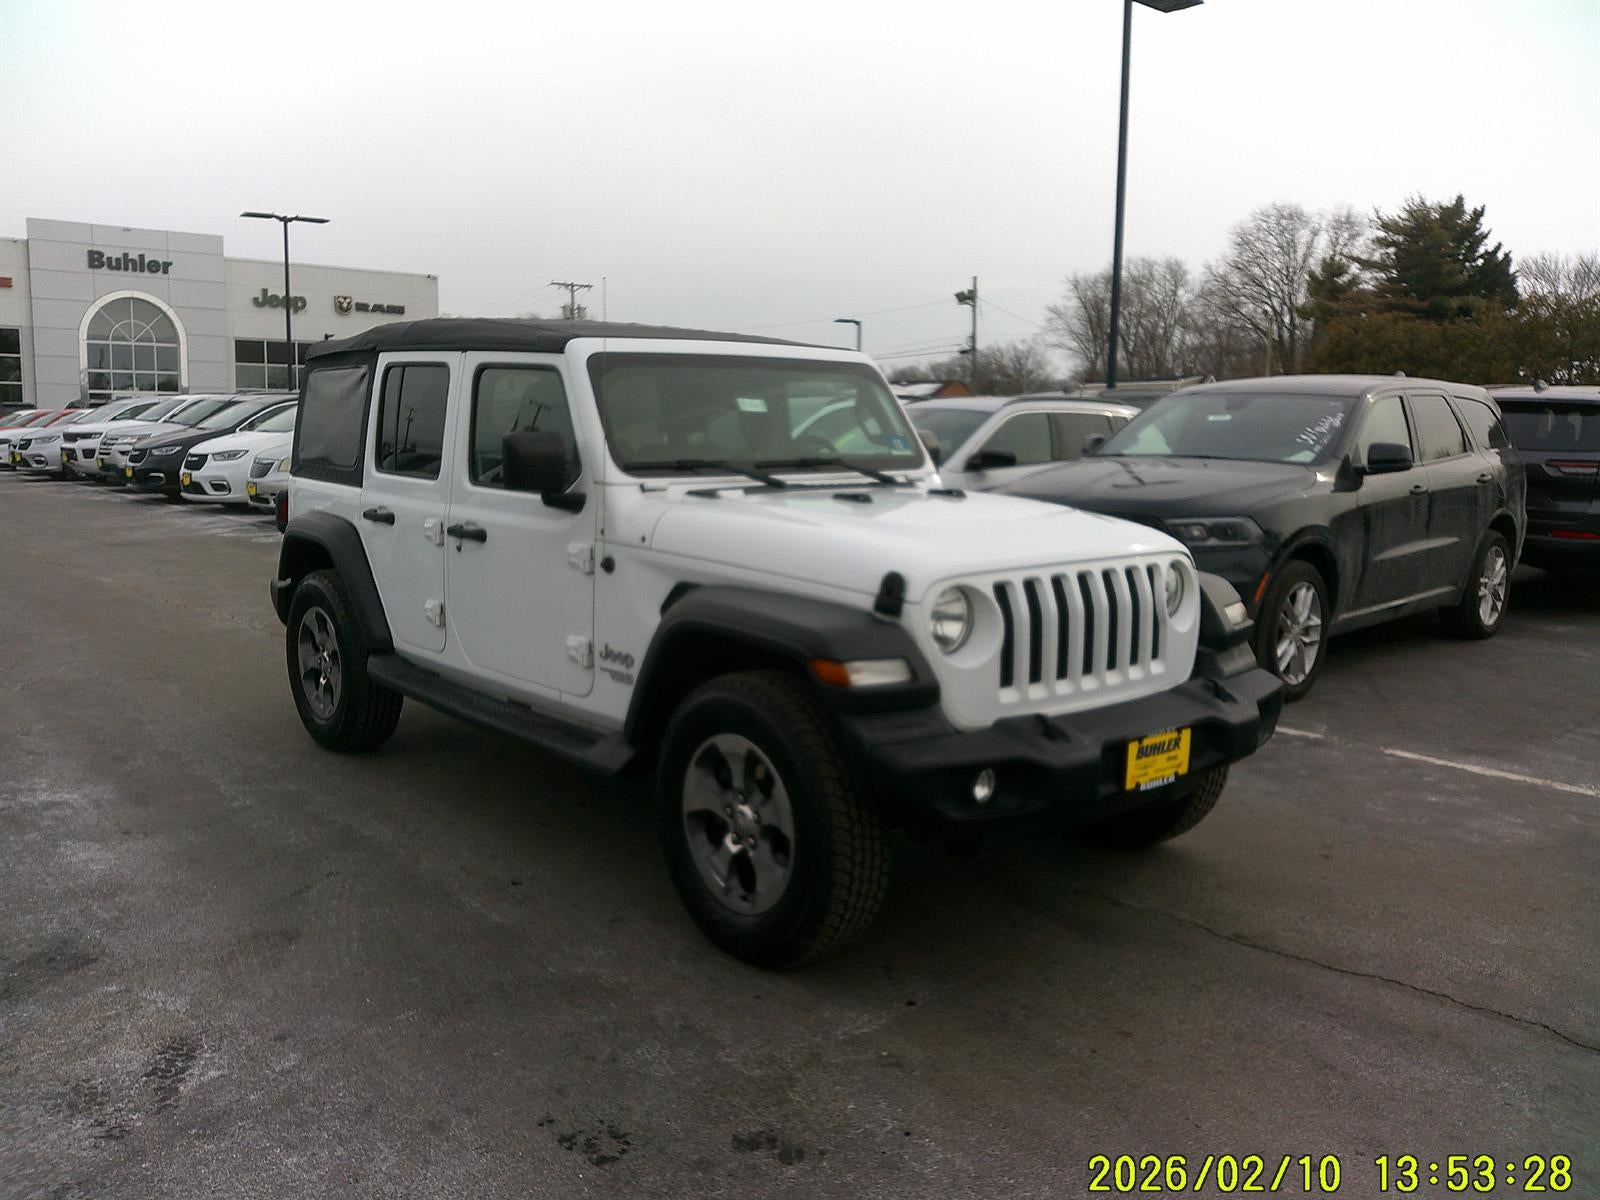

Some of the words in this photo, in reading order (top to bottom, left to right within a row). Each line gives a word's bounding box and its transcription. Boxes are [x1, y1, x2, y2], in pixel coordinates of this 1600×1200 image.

[87, 250, 173, 274] Buhler
[253, 288, 307, 314] Jeep
[1137, 736, 1182, 759] BUHLER
